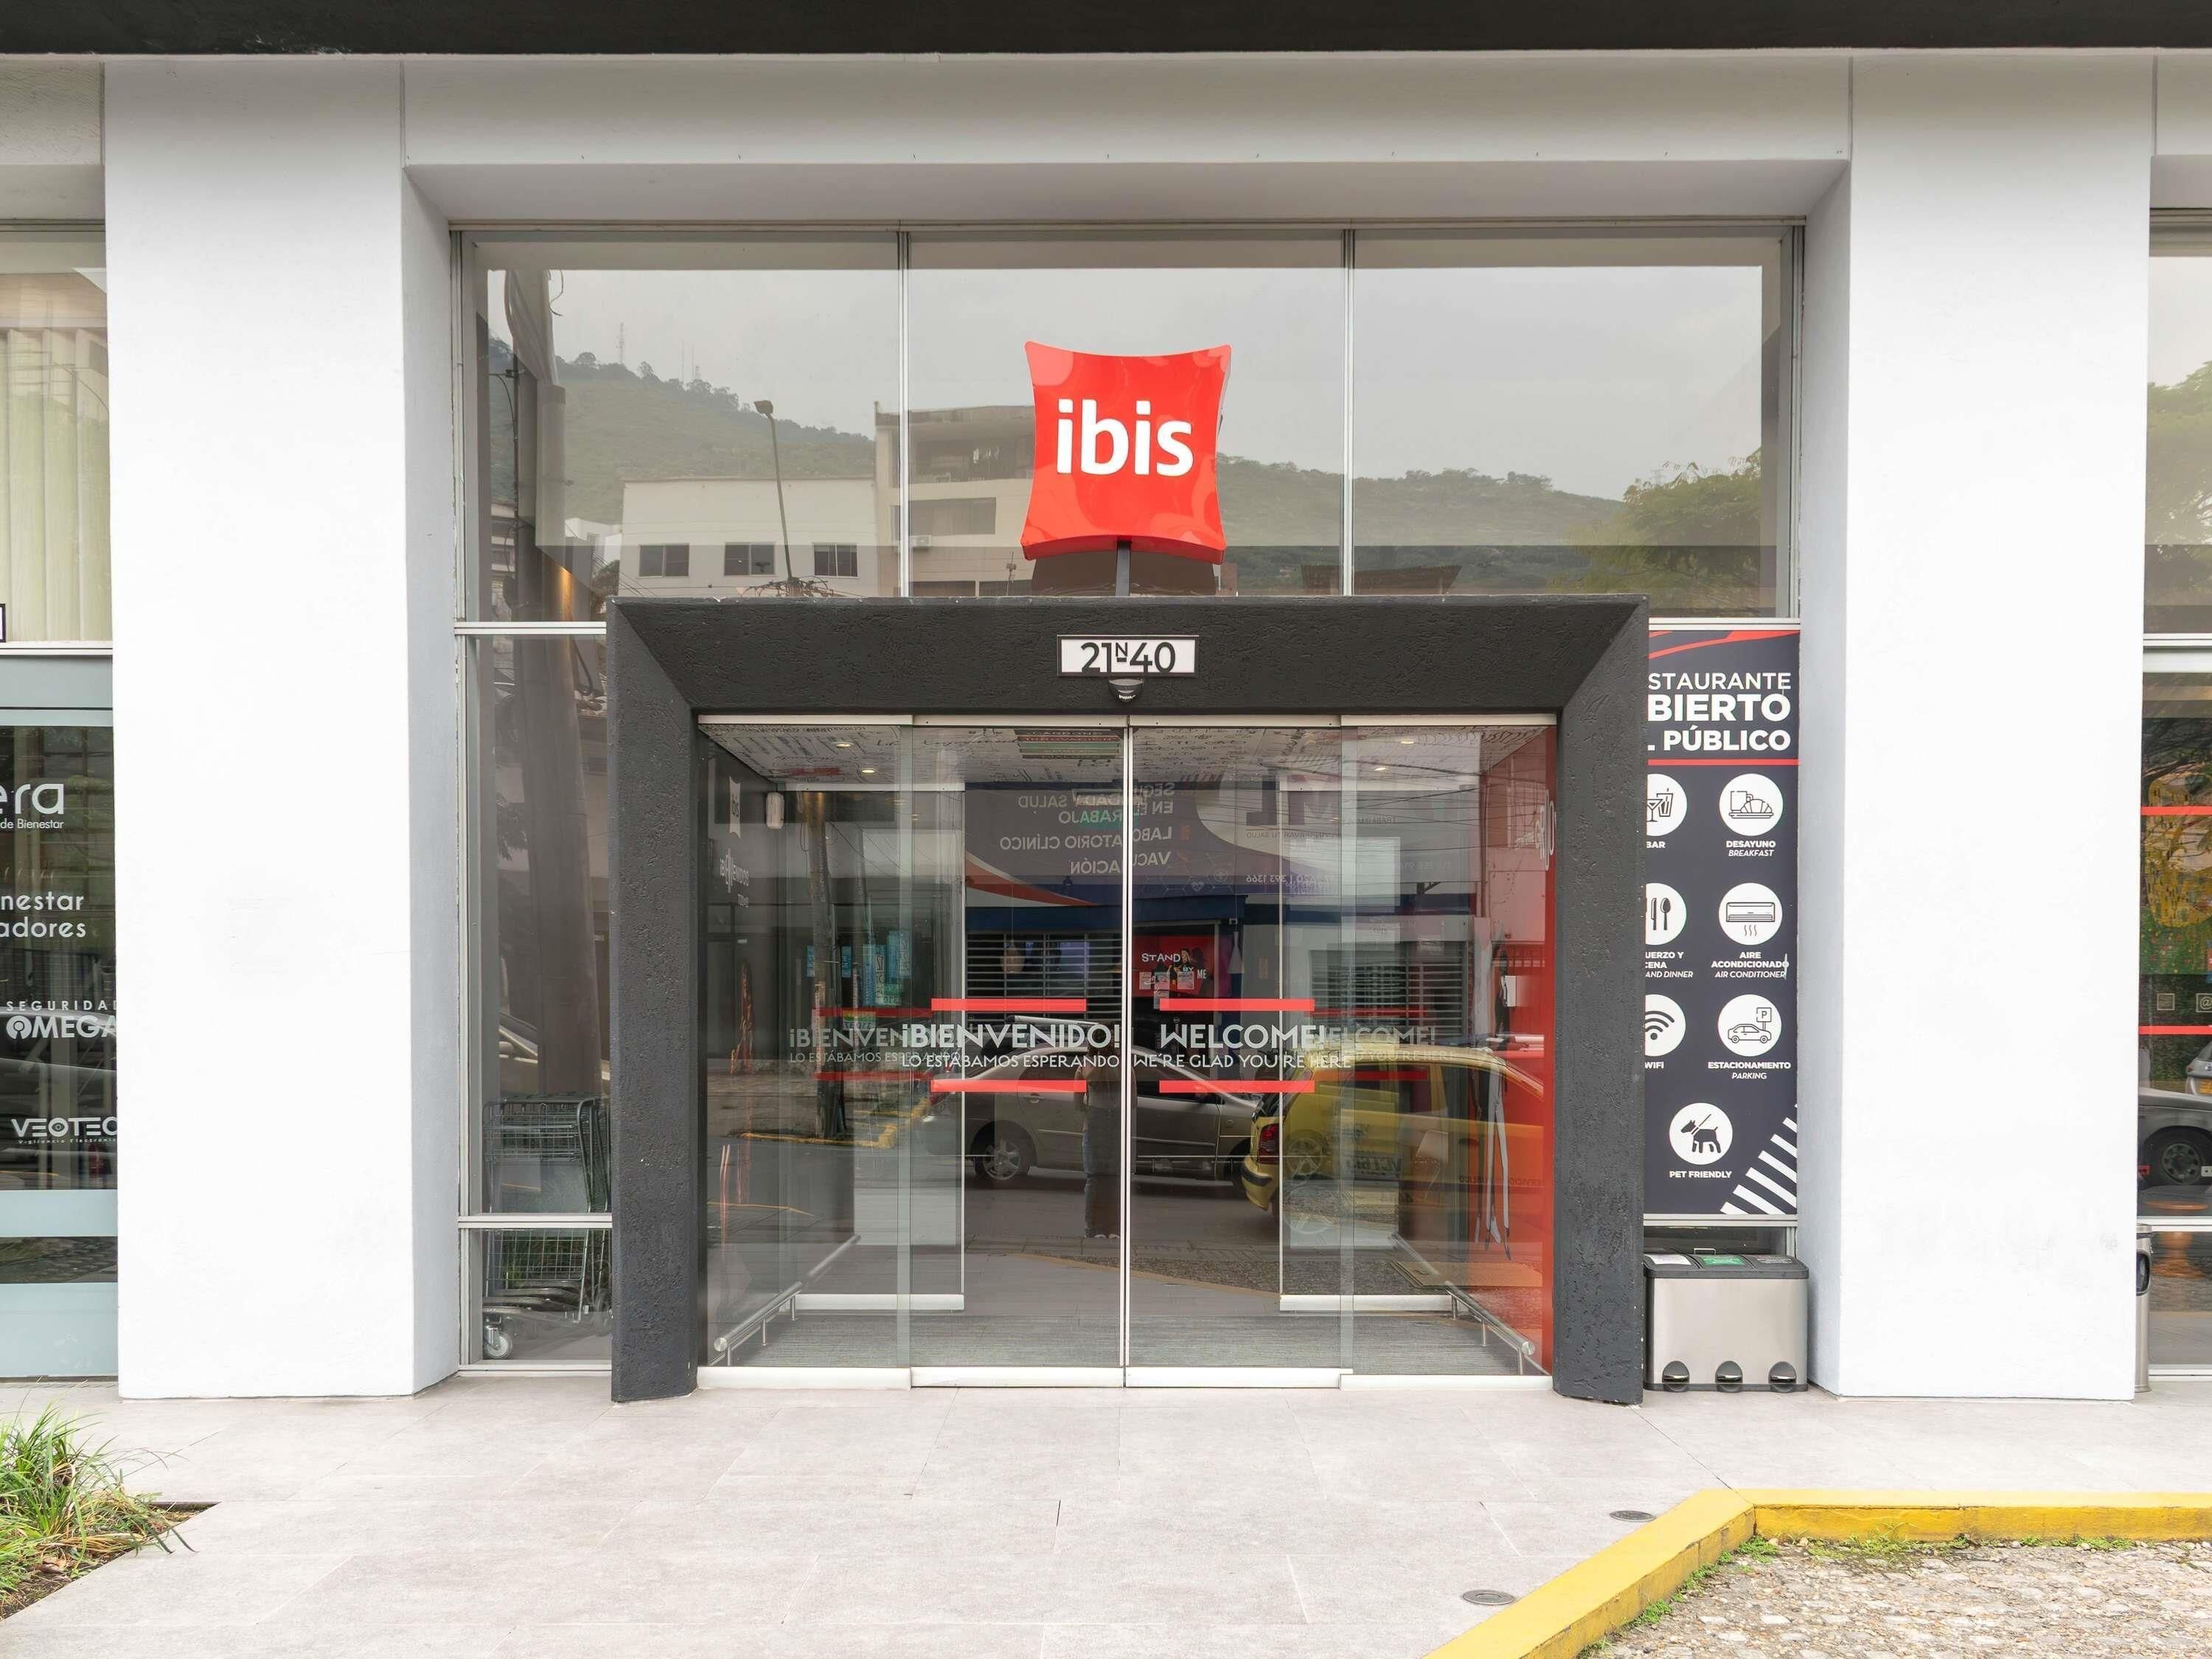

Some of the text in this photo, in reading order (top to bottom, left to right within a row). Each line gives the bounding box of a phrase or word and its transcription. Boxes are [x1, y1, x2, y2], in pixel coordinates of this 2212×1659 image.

[1057, 399, 1194, 477] ibis
[1648, 672, 1791, 690] STAURANTE
[1648, 693, 1791, 722] BIERTO
[1663, 725, 1791, 751] PÚBLICO
[0, 784, 64, 814] ra
[1, 818, 64, 829] de Bienestar
[1, 891, 84, 911] nestar
[0, 917, 86, 938] adores
[1141, 953, 1180, 962] STAND
[1197, 969, 1207, 979] ME
[6, 1000, 116, 1012] SEGURIDA
[1161, 1023, 1324, 1048] WELCOME!
[902, 1051, 1120, 1068] LO ESTÁBAMOS ESPERANDO
[1189, 1054, 1234, 1068] GLAD
[1310, 1054, 1352, 1068] HERE
